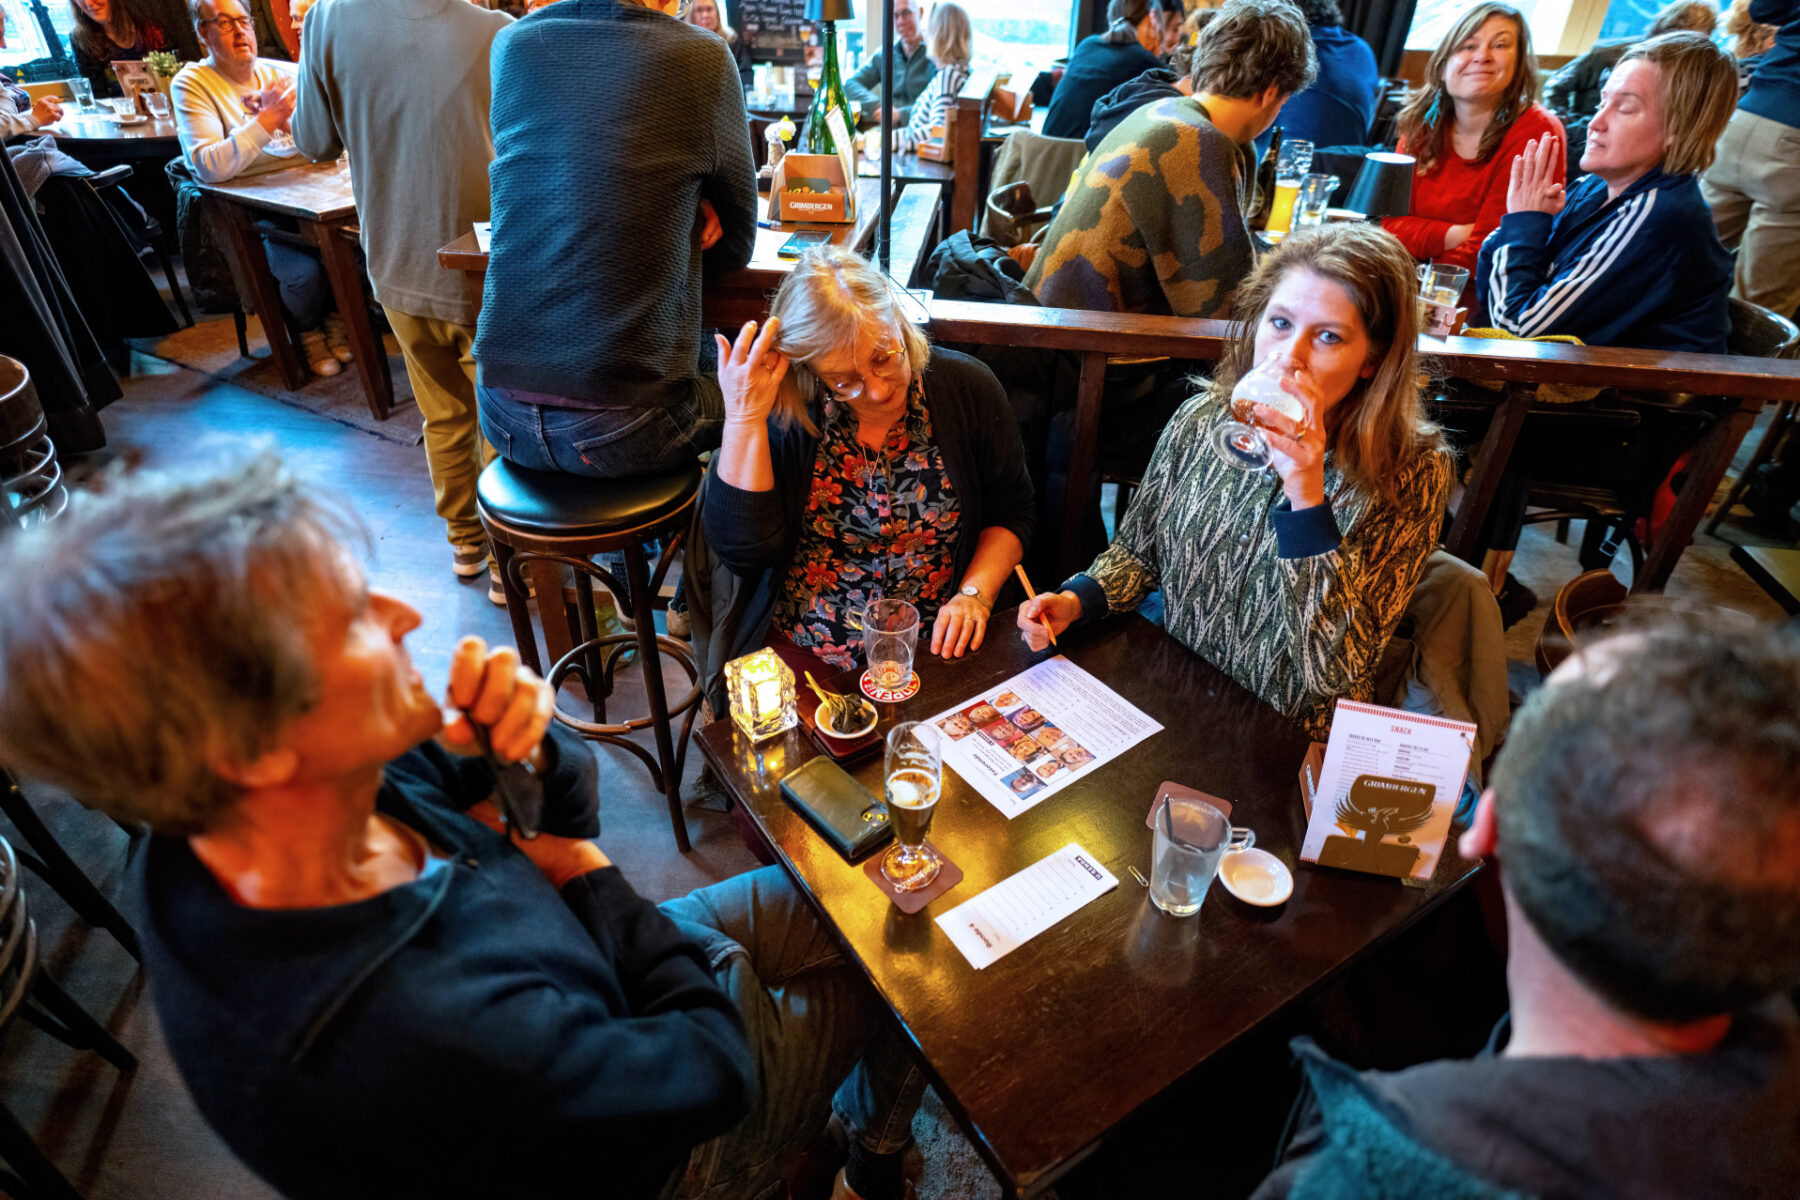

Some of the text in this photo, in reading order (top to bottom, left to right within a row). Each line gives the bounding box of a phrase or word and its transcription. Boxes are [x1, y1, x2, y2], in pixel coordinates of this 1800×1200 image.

[789, 201, 833, 211] GRIMBERGEN
[1390, 725, 1412, 735] SNACK
[1363, 779, 1427, 795] GRIMBERGEN
[973, 927, 993, 949] Ronde
